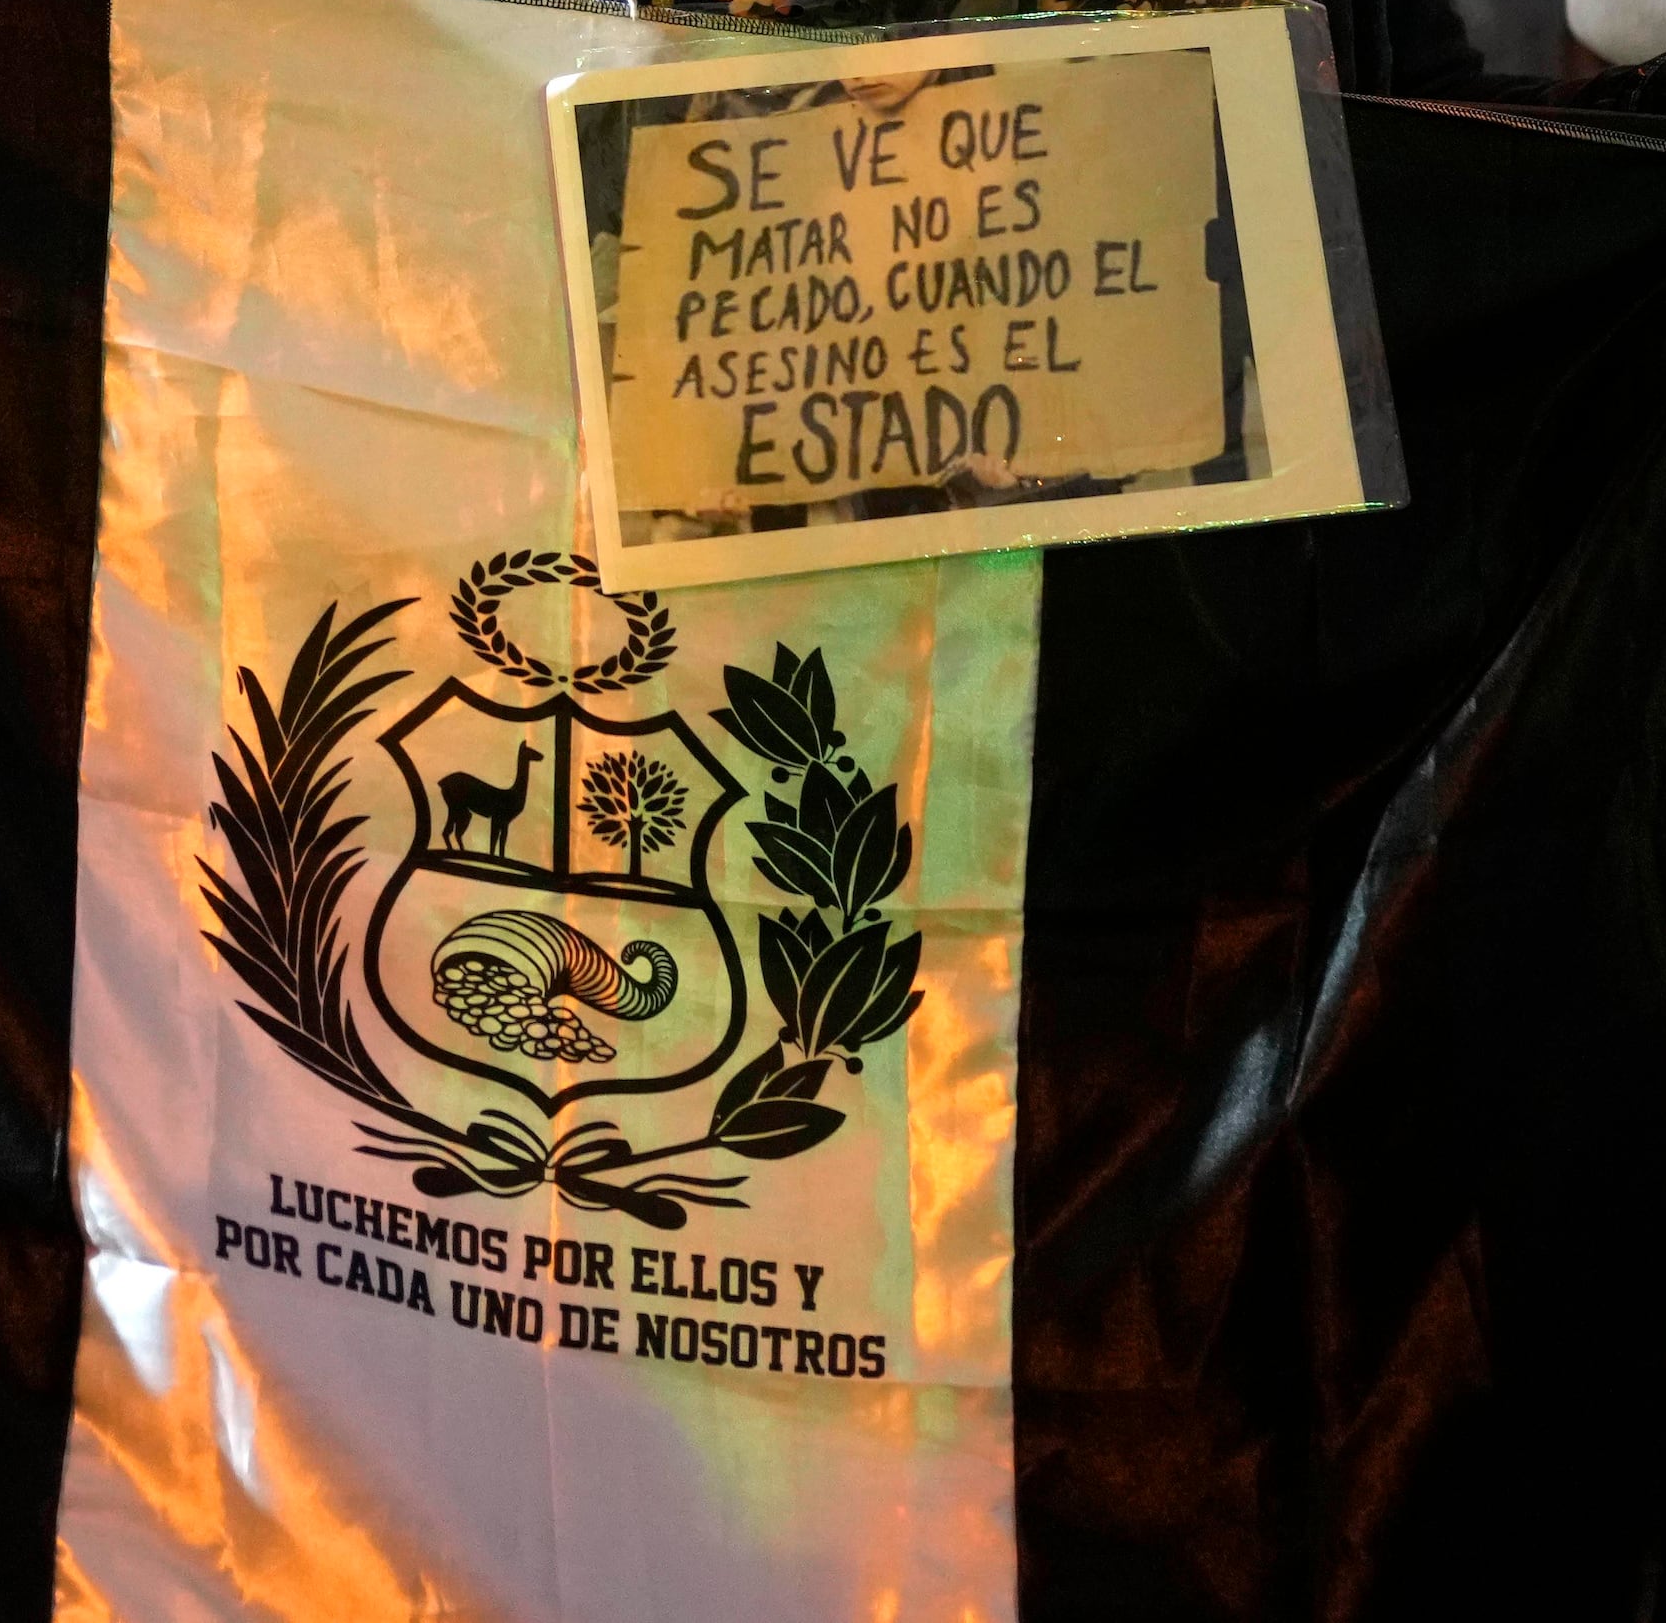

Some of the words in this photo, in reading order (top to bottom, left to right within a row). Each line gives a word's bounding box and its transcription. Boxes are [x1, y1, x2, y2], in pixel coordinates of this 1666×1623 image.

[677, 138, 788, 220] SE
[833, 117, 906, 191] VE
[941, 103, 1049, 172] QUE
[689, 212, 853, 281] MATAR
[892, 194, 951, 252] NO
[978, 180, 1041, 237] ES
[676, 273, 874, 342] PECADO,
[887, 249, 1072, 312] CUANDO
[1093, 241, 1158, 298] EL
[674, 335, 886, 399] ASESINO
[907, 324, 971, 377] ES
[1003, 318, 1080, 374] EL
[736, 384, 1020, 486] ESTADO
[269, 1174, 507, 1273] LUCHEMOS
[523, 1235, 615, 1289] POR
[631, 1248, 778, 1307] ELLOS
[795, 1265, 825, 1311] Y
[215, 1215, 300, 1277] POR
[316, 1245, 436, 1317] CADA
[451, 1283, 543, 1344] UNO
[559, 1306, 620, 1355] DE
[635, 1314, 887, 1379] NOSOTROS
